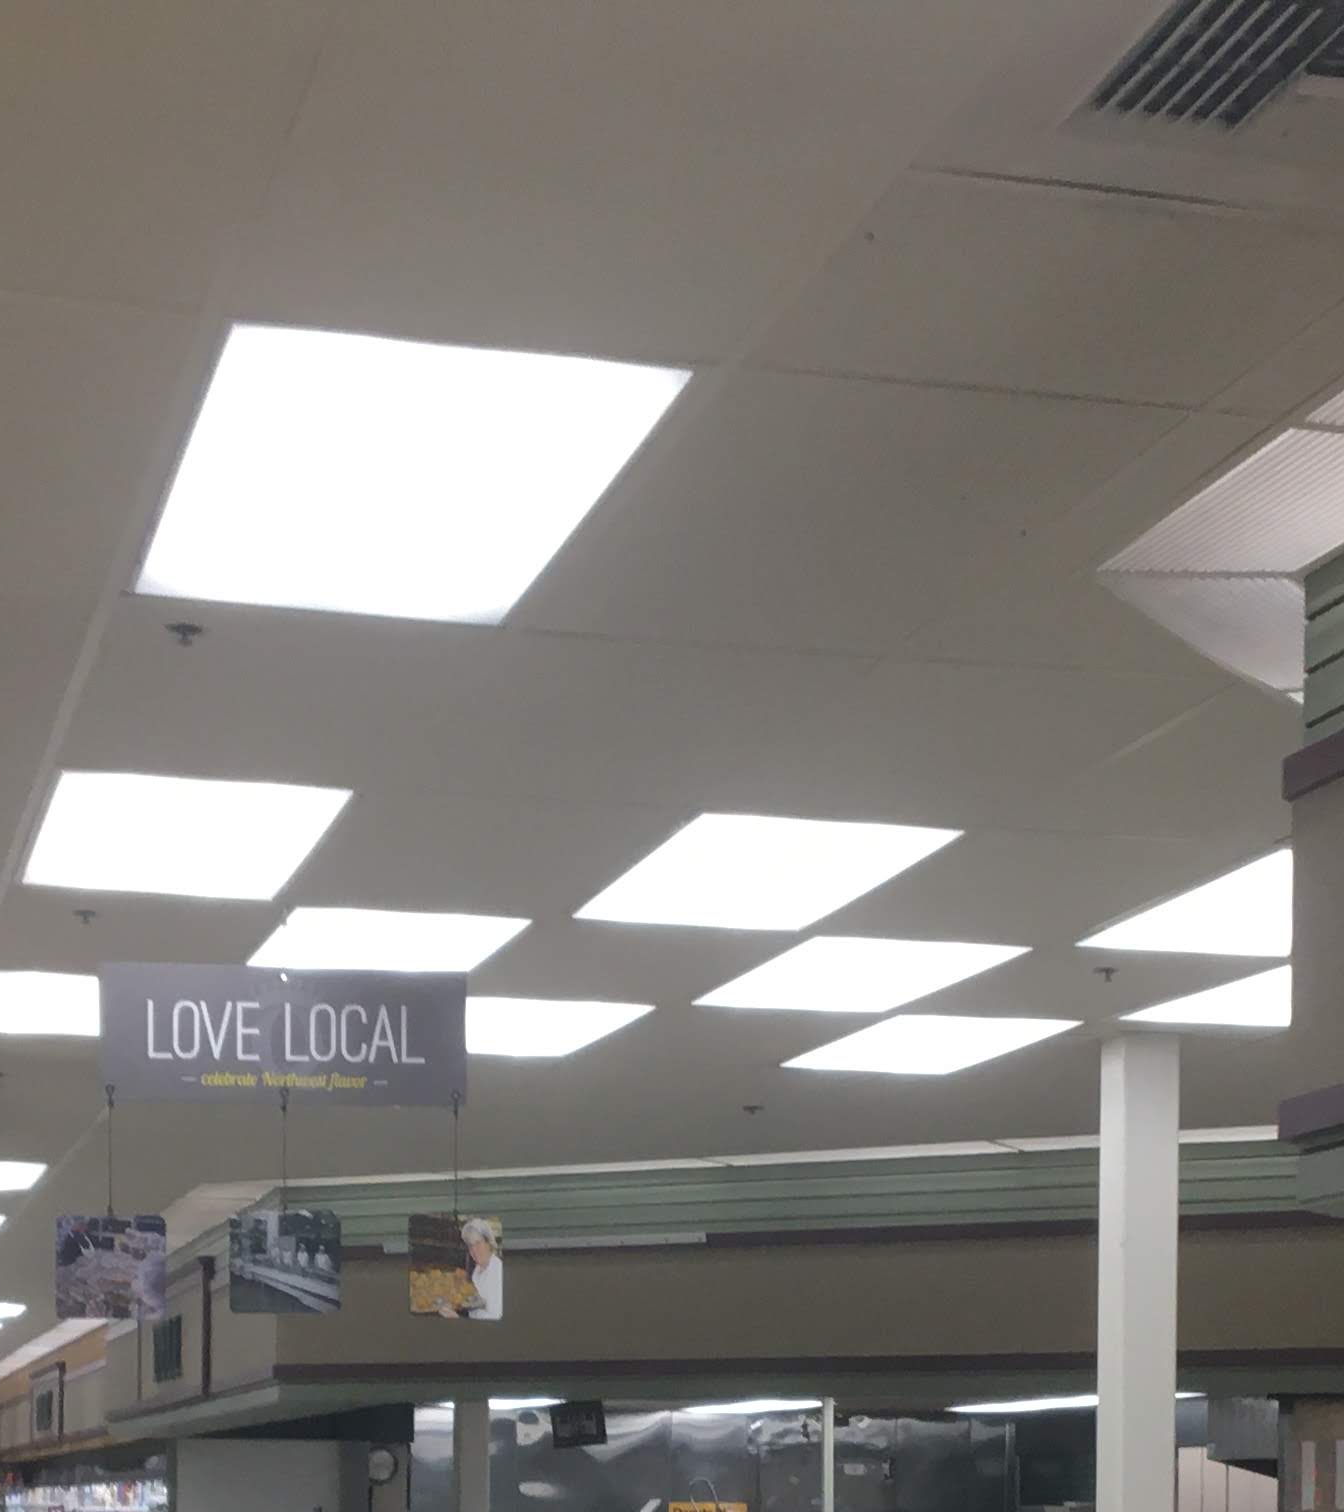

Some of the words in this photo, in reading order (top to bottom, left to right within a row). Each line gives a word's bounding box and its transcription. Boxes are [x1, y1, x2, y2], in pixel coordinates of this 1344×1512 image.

[145, 999, 260, 1062] LOVE
[283, 1003, 426, 1065] LOCAL
[200, 1071, 257, 1087] celebrate
